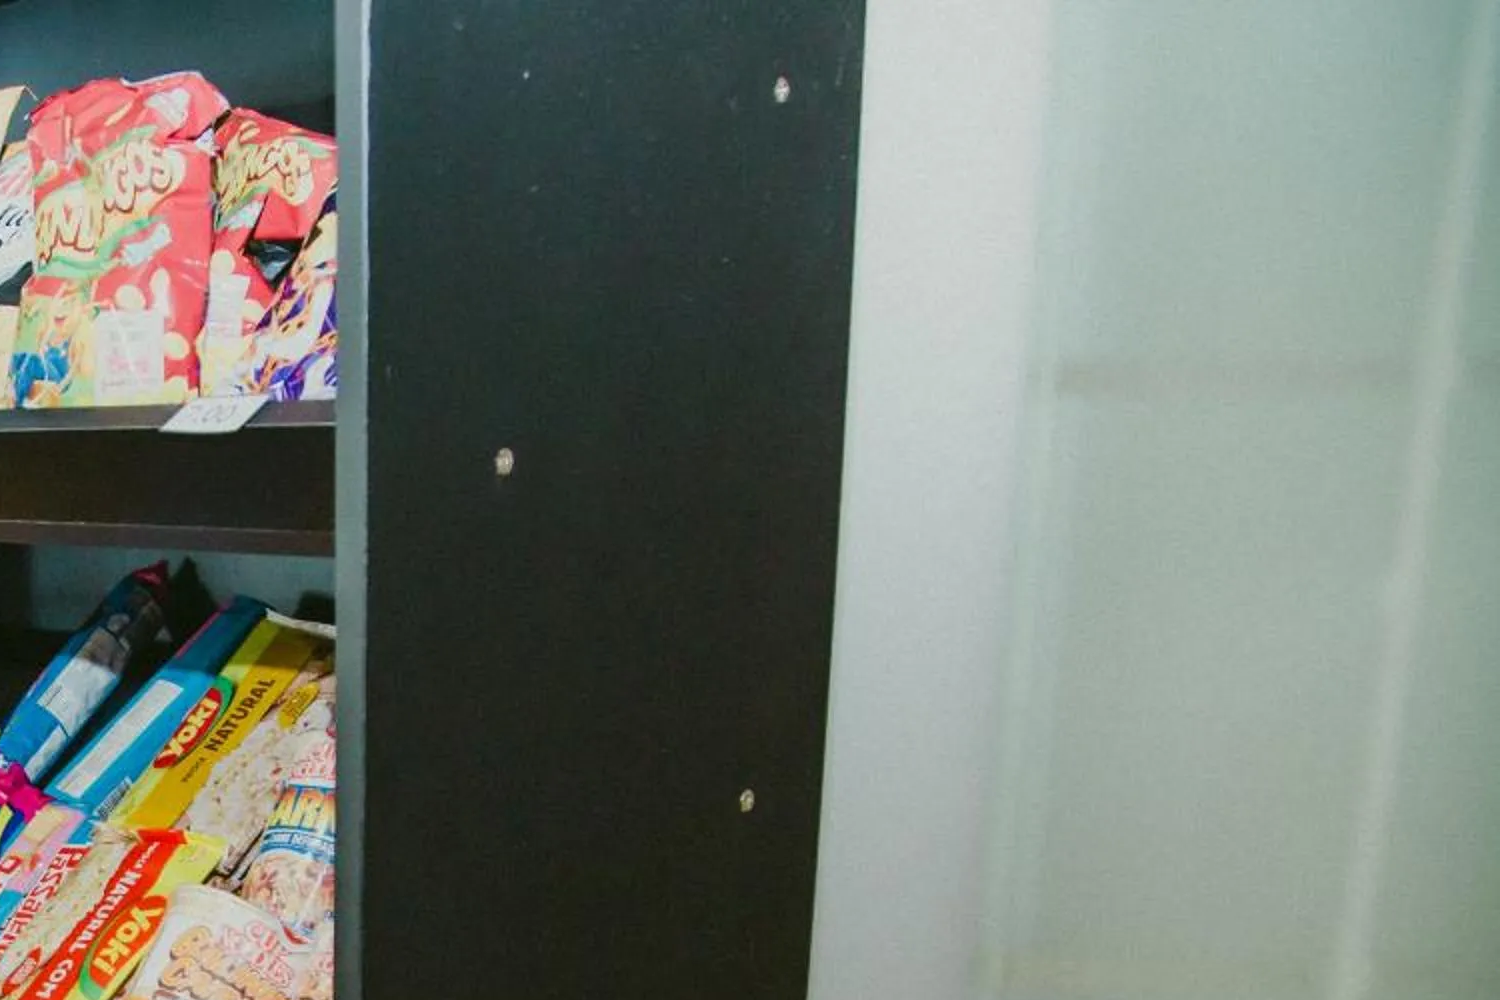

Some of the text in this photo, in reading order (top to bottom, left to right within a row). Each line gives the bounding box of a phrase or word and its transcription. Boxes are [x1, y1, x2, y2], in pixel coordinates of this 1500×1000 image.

[208, 677, 277, 753] NATURAL
[67, 862, 145, 959] NATURAL
[37, 956, 75, 1000] COM
